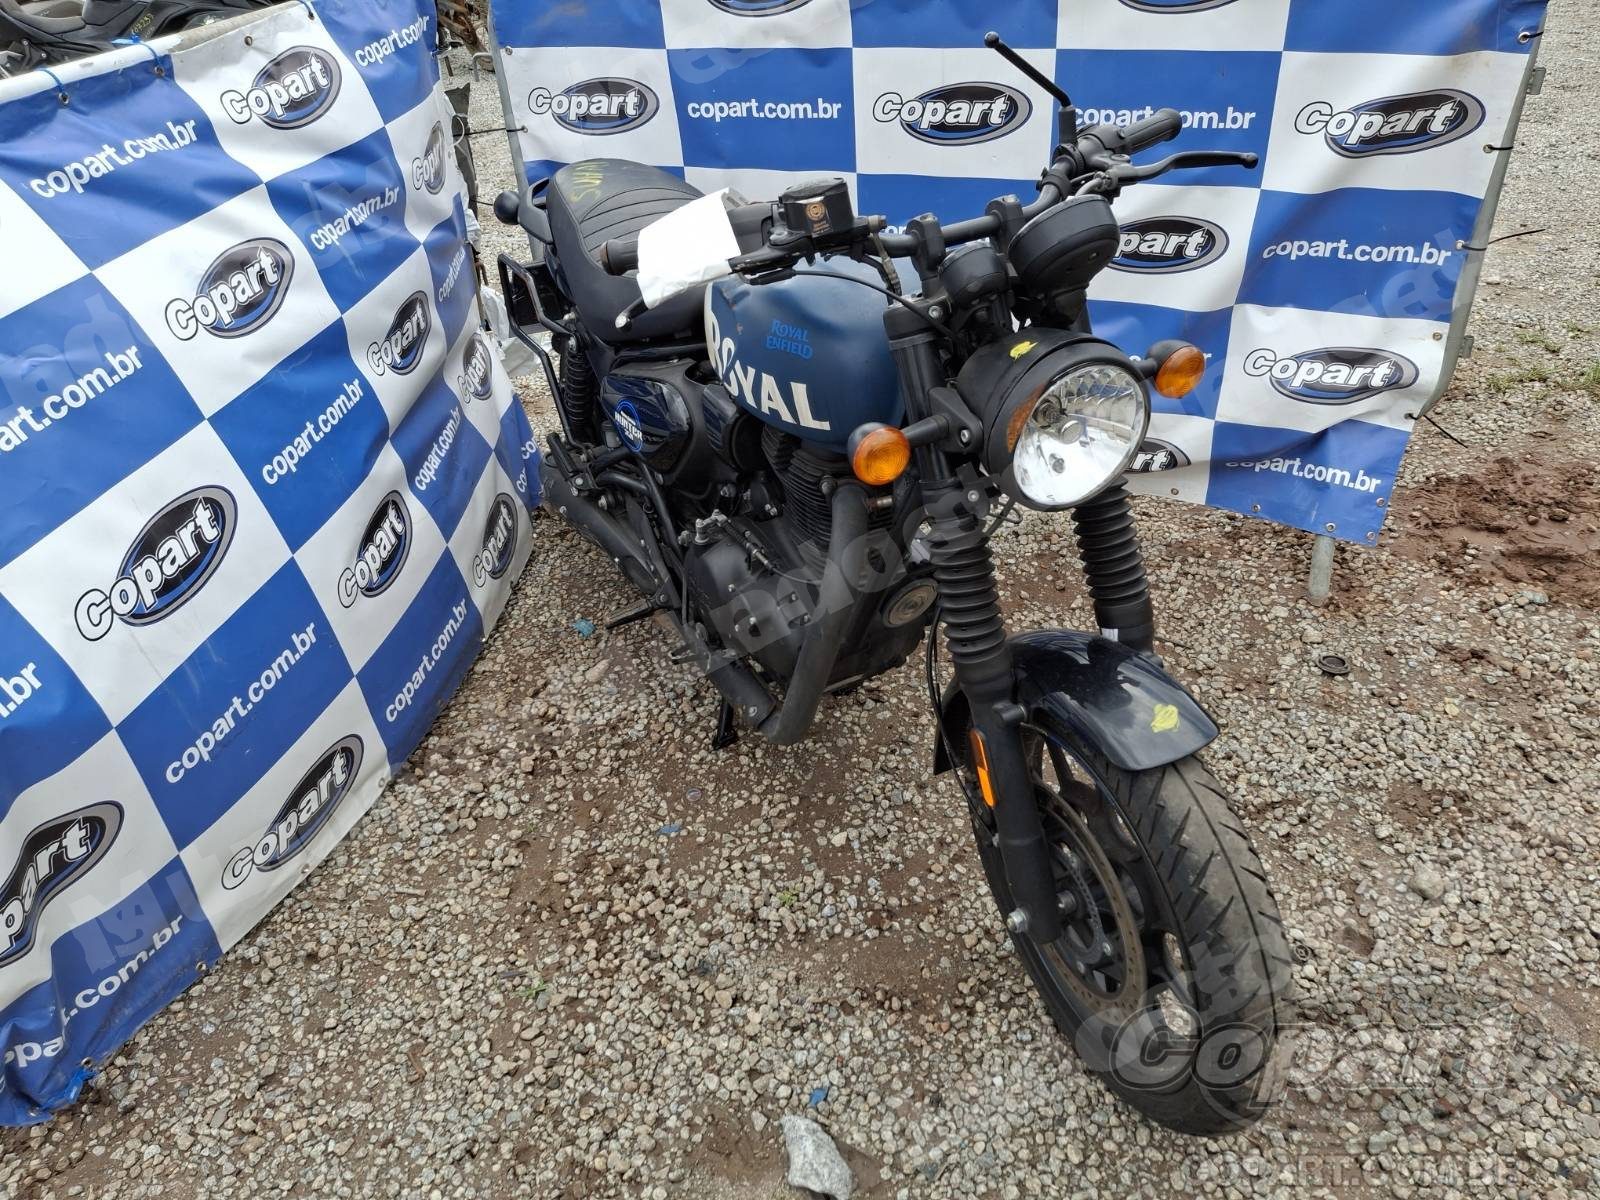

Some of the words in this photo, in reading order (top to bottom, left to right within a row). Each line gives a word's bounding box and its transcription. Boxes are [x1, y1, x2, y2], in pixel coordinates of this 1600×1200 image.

[220, 50, 330, 124] Copart
[528, 87, 641, 120] Copart
[687, 98, 842, 121] copart.com.br
[873, 91, 1010, 130] Copart
[1295, 97, 1463, 147] Copart
[30, 119, 198, 199] copart.com.br
[1113, 227, 1208, 260] part
[1263, 239, 1452, 267] copart.com.br
[165, 246, 282, 342] Copart
[770, 319, 809, 342] ROYAL
[367, 299, 427, 376] Copart
[704, 282, 831, 431] ROYAL
[766, 335, 814, 360] ENFIELD
[1243, 348, 1396, 389] Copart
[0, 345, 143, 452] art.com.br
[262, 377, 363, 486] copart.com.br
[74, 496, 220, 642] Copart
[337, 501, 407, 609] Copart
[472, 502, 512, 588] Copart
[387, 599, 467, 722] copart.com.br
[165, 622, 318, 784] copart.com.br
[221, 748, 348, 890] Copart
